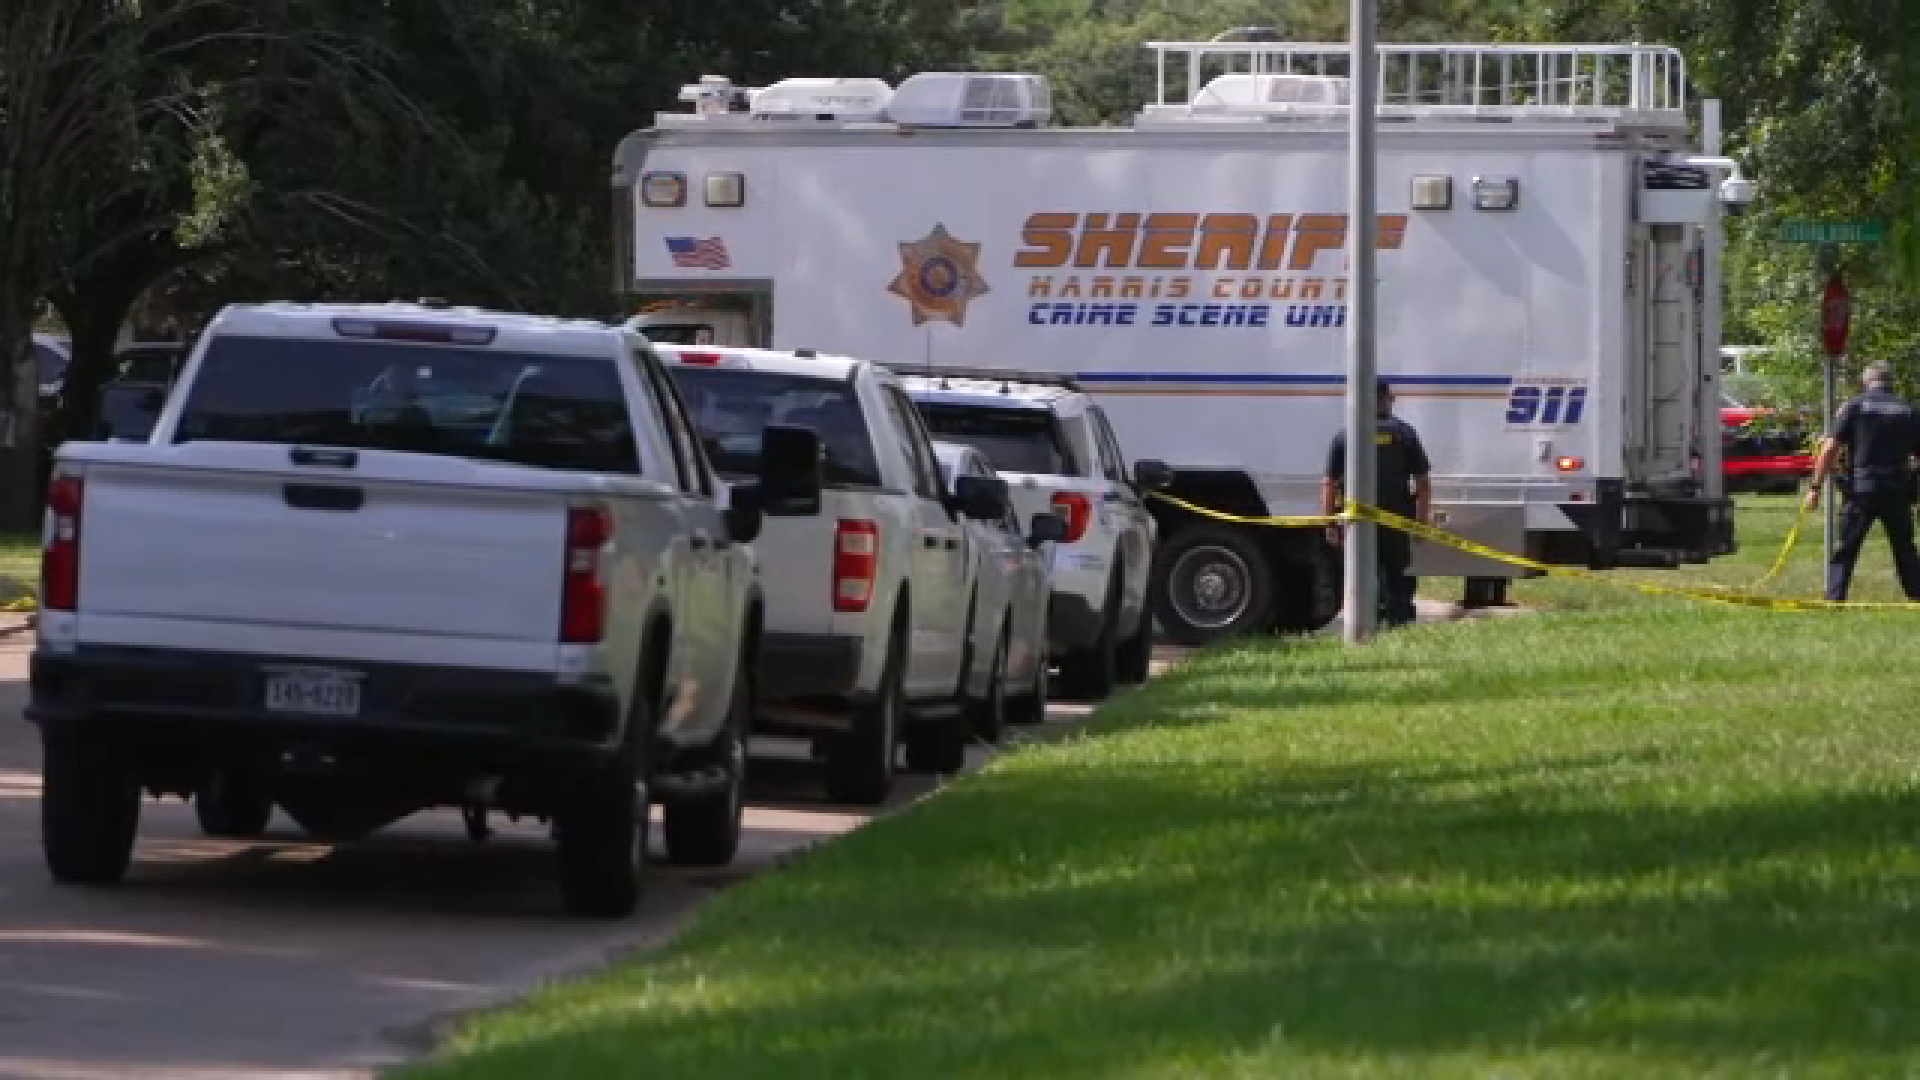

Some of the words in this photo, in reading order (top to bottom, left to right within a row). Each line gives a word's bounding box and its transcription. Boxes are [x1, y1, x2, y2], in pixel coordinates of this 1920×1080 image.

[1028, 275, 1192, 298] HARRIS
[1212, 278, 1349, 299] COUNT
[1028, 303, 1138, 325] CRIME
[1150, 304, 1270, 327] SCENE
[1285, 305, 1348, 328] UNI
[1505, 386, 1588, 424] 911
